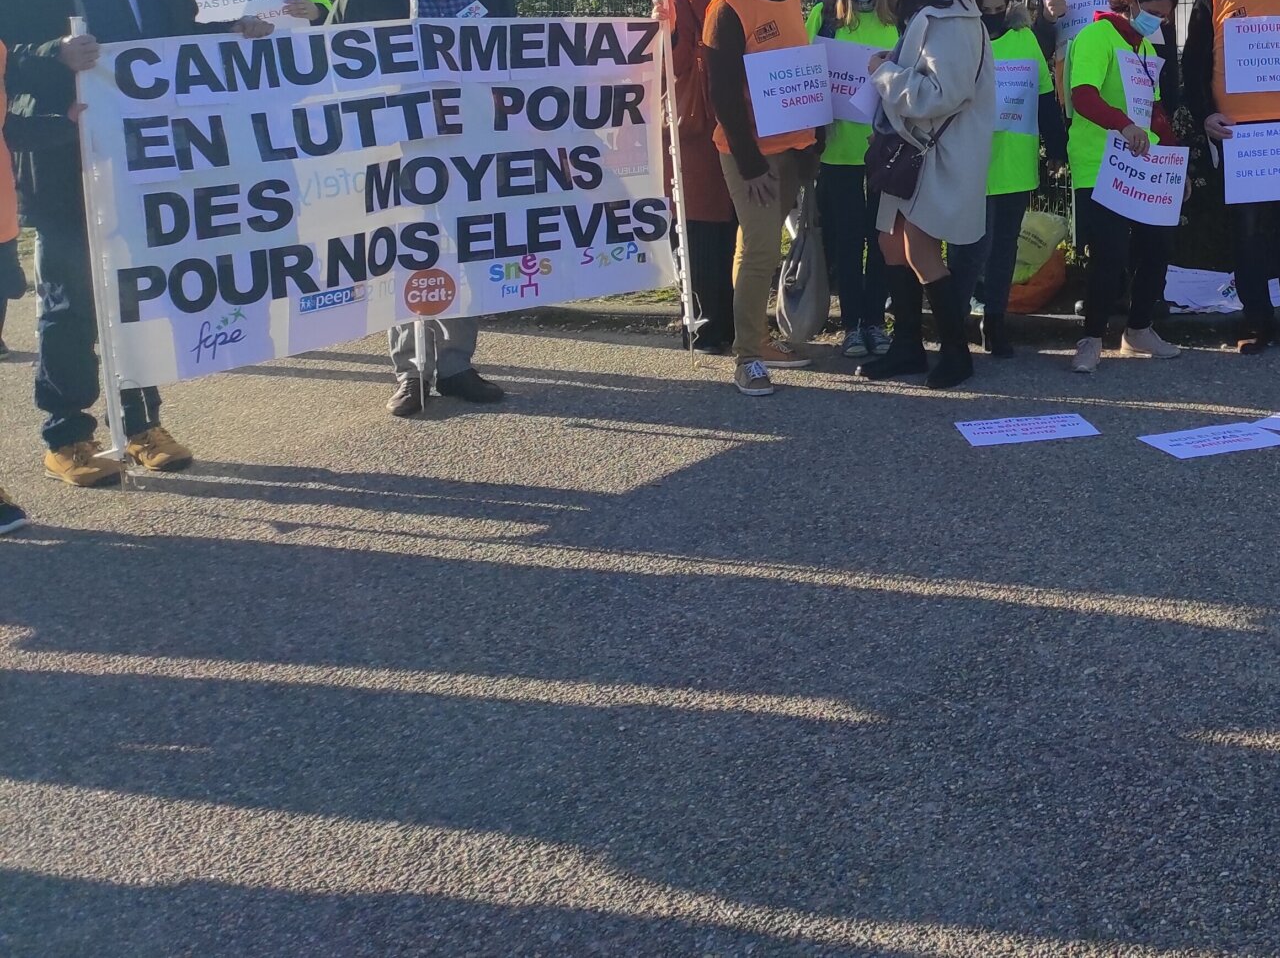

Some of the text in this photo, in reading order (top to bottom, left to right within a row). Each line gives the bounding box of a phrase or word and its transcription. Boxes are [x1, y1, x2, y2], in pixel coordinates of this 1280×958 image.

[114, 22, 660, 100] CAMUSERMENAZ
[769, 70, 793, 82] NOS
[1256, 75, 1267, 83] DE
[763, 88, 777, 98] NE
[779, 83, 801, 95] SONT
[803, 79, 820, 91] PAS
[781, 92, 824, 109] SARDINES
[123, 83, 645, 172] EN LUTTE POUR
[1237, 149, 1269, 158] BAISSE
[1270, 148, 1280, 156] DE
[1108, 155, 1182, 185] Corps et Tête
[1236, 169, 1253, 178] SUR
[1255, 168, 1266, 176] LE
[143, 145, 603, 248] DES MOYENS
[1111, 177, 1173, 205] Malmenés
[118, 198, 668, 324] POUR NOS ELEVES
[411, 275, 445, 289] sgen
[501, 283, 519, 298] fsu
[315, 287, 350, 309] peep
